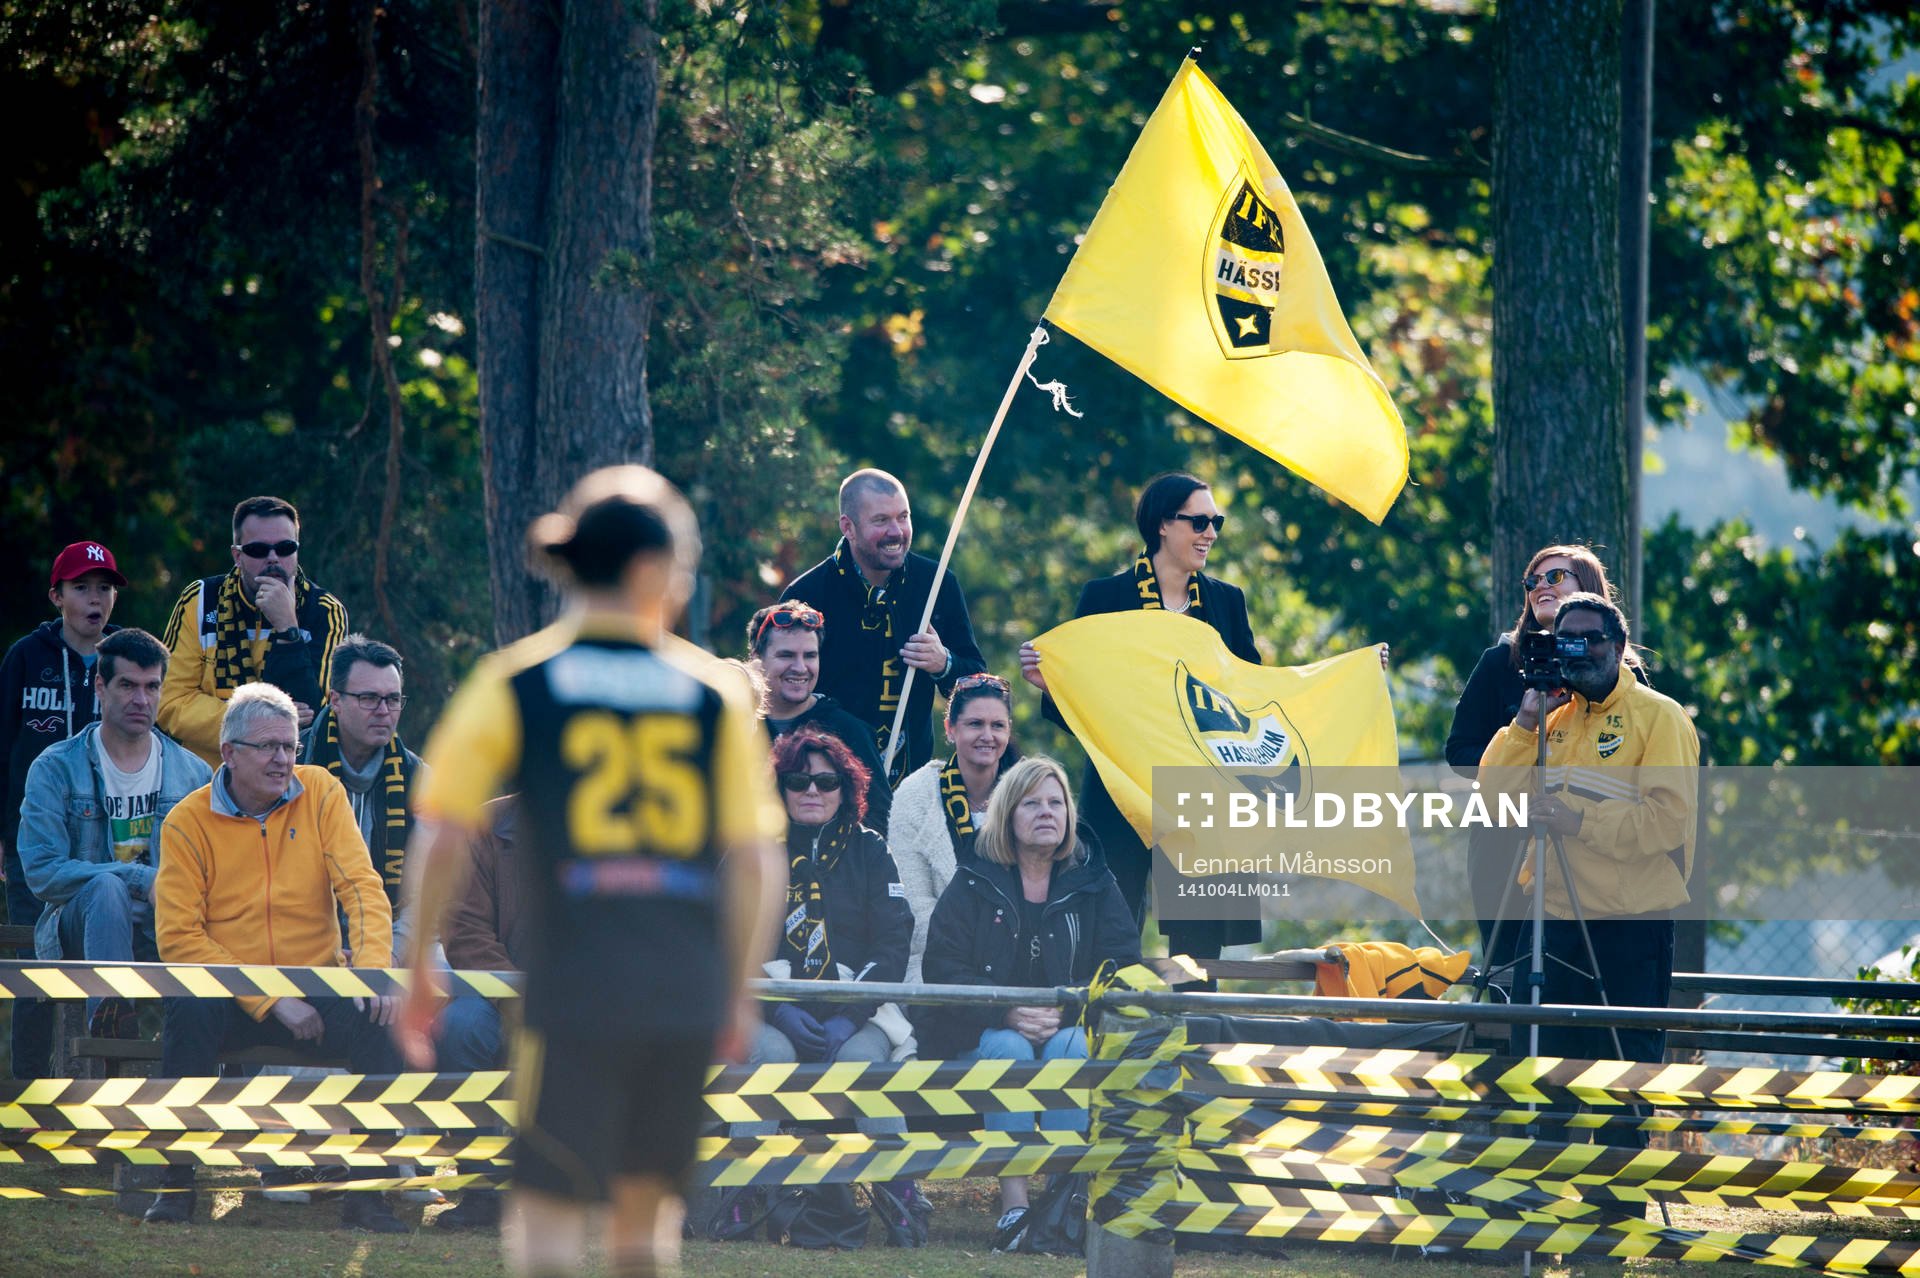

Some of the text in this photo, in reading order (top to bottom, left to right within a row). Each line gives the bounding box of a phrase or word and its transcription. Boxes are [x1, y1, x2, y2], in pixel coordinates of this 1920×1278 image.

[86, 545, 105, 562] NY
[1217, 729, 1286, 766] HÄSSEHOLM
[563, 709, 706, 857] 25
